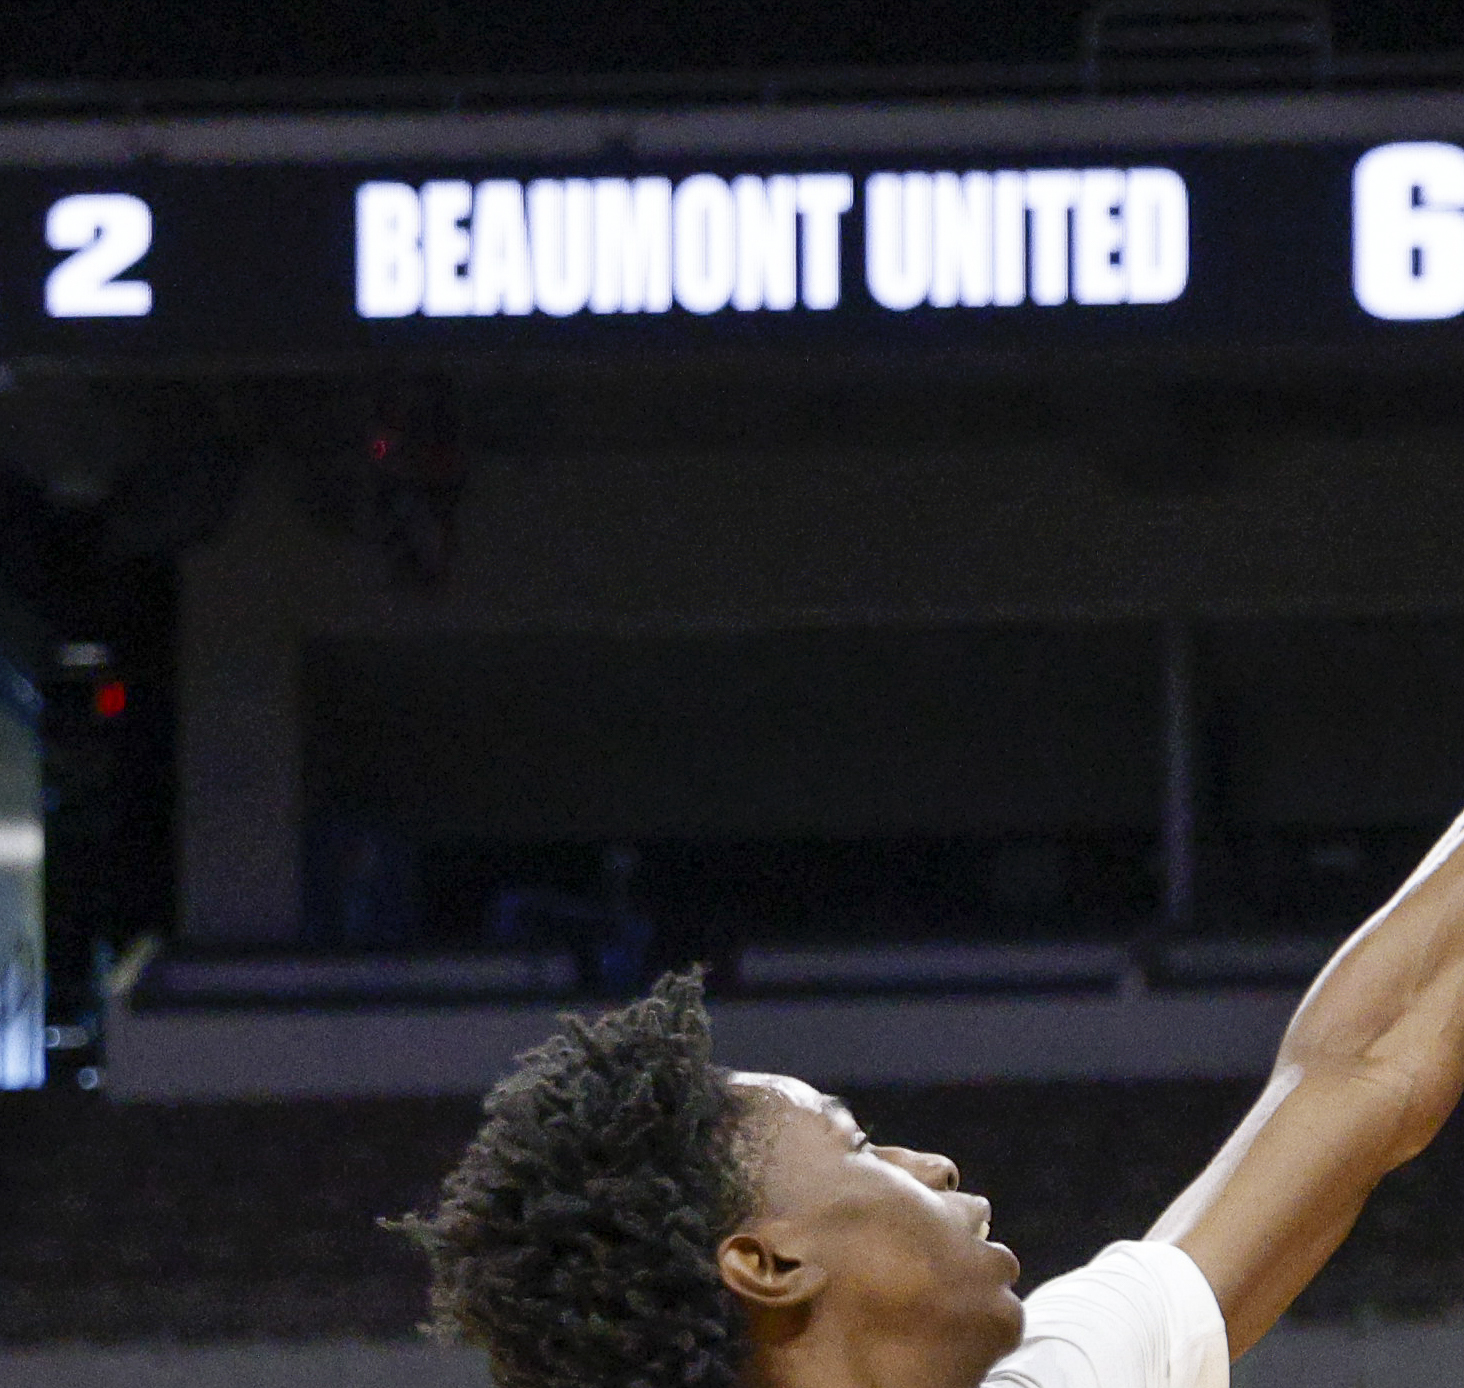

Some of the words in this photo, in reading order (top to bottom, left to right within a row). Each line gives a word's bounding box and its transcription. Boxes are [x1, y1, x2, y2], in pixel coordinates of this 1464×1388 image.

[45, 193, 153, 318] 2
[355, 173, 854, 318] BEAUMONT
[865, 167, 1191, 312] UNITED
